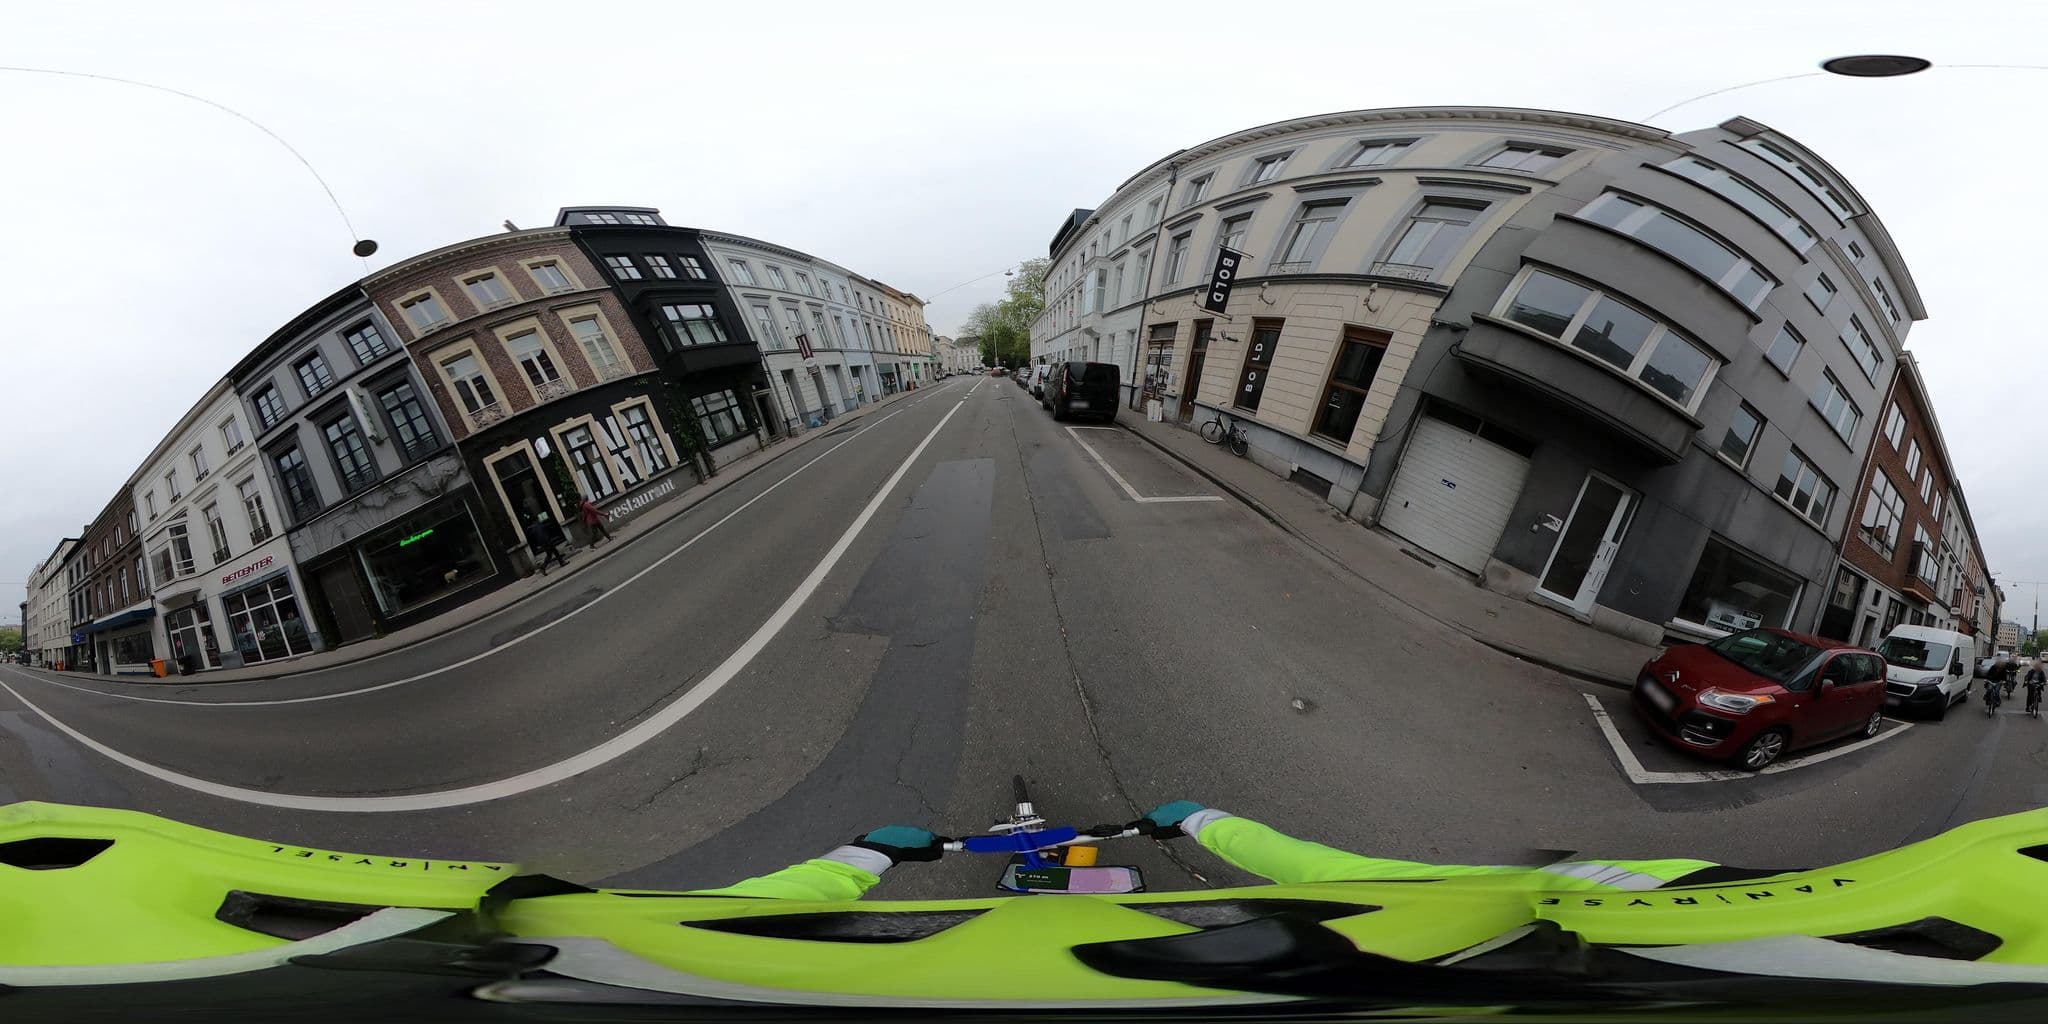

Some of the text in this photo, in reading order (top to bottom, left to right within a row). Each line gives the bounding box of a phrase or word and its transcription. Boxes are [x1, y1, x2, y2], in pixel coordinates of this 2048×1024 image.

[1213, 257, 1235, 303] BOLD
[1245, 343, 1263, 392] BOLD
[608, 478, 675, 521] restaurant
[222, 555, 273, 584] BETCENTER
